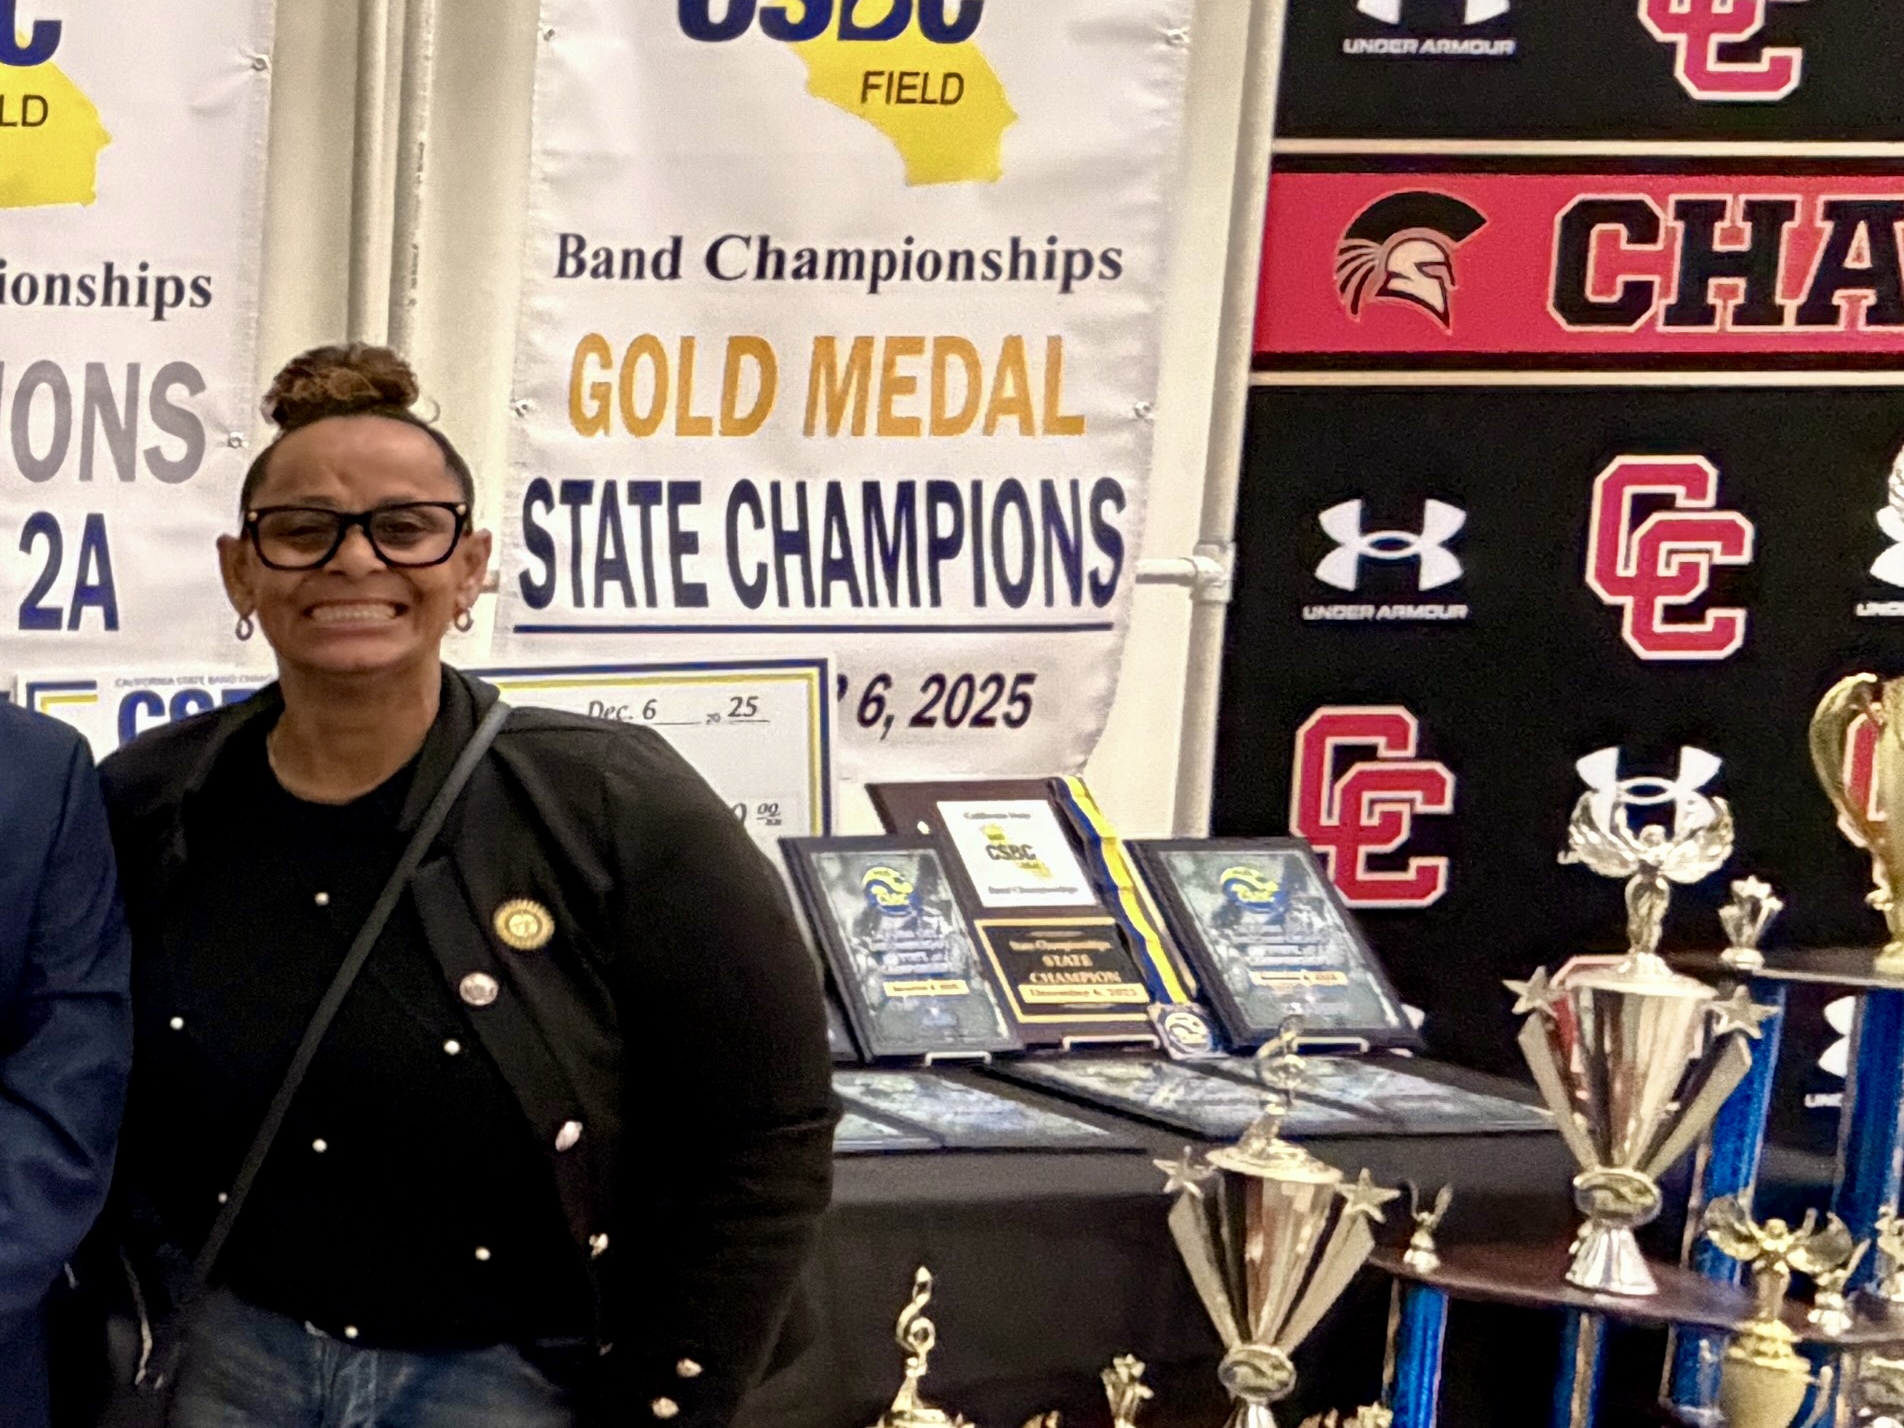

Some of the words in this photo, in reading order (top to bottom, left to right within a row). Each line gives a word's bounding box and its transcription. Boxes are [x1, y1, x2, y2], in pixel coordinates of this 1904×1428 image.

[1342, 38, 1417, 56] UNDER
[1418, 38, 1517, 57] ARMOUR
[860, 70, 965, 105] FIELD
[553, 232, 684, 281] Band
[703, 233, 1125, 295] Championships
[566, 332, 779, 438] GOLD
[802, 334, 1087, 438] MEDAL
[518, 475, 710, 610] STATE
[724, 475, 1129, 610] CHAMPIONS
[17, 510, 120, 632] 2A
[1302, 605, 1376, 621] UNDER
[1376, 604, 1469, 621] ARMOUR
[642, 698, 659, 721] 6
[727, 696, 760, 719] 25
[857, 673, 894, 741] 6,
[908, 672, 1039, 730] 2025
